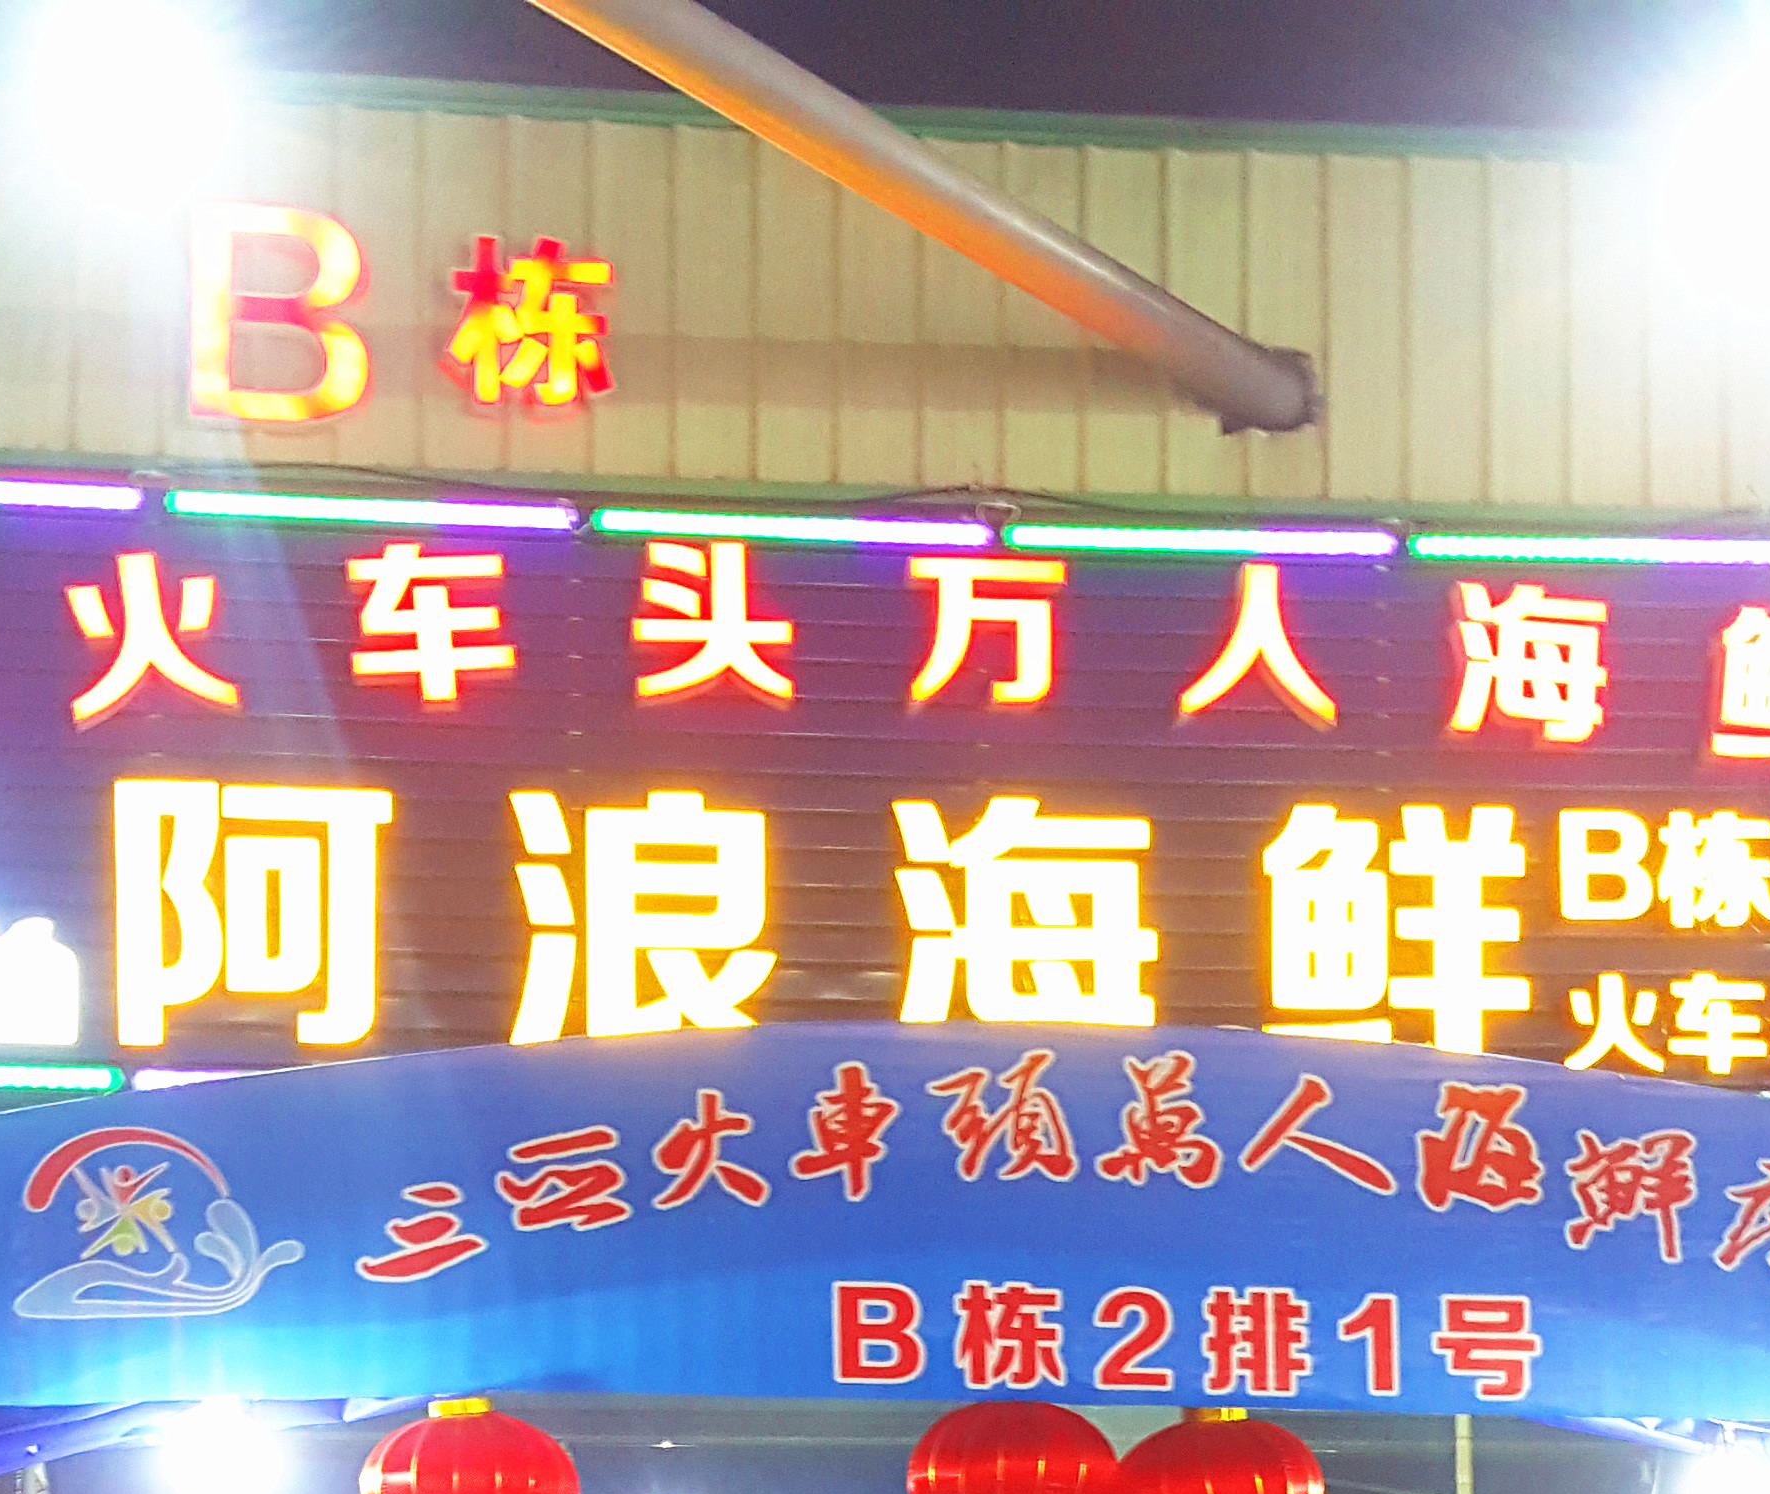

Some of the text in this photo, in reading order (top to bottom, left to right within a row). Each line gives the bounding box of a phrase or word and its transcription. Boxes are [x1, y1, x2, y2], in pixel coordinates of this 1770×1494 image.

[185, 198, 619, 424] B栋
[110, 777, 1533, 1053] 阿浪海鲜
[832, 1279, 1541, 1404] B栋2排1号
